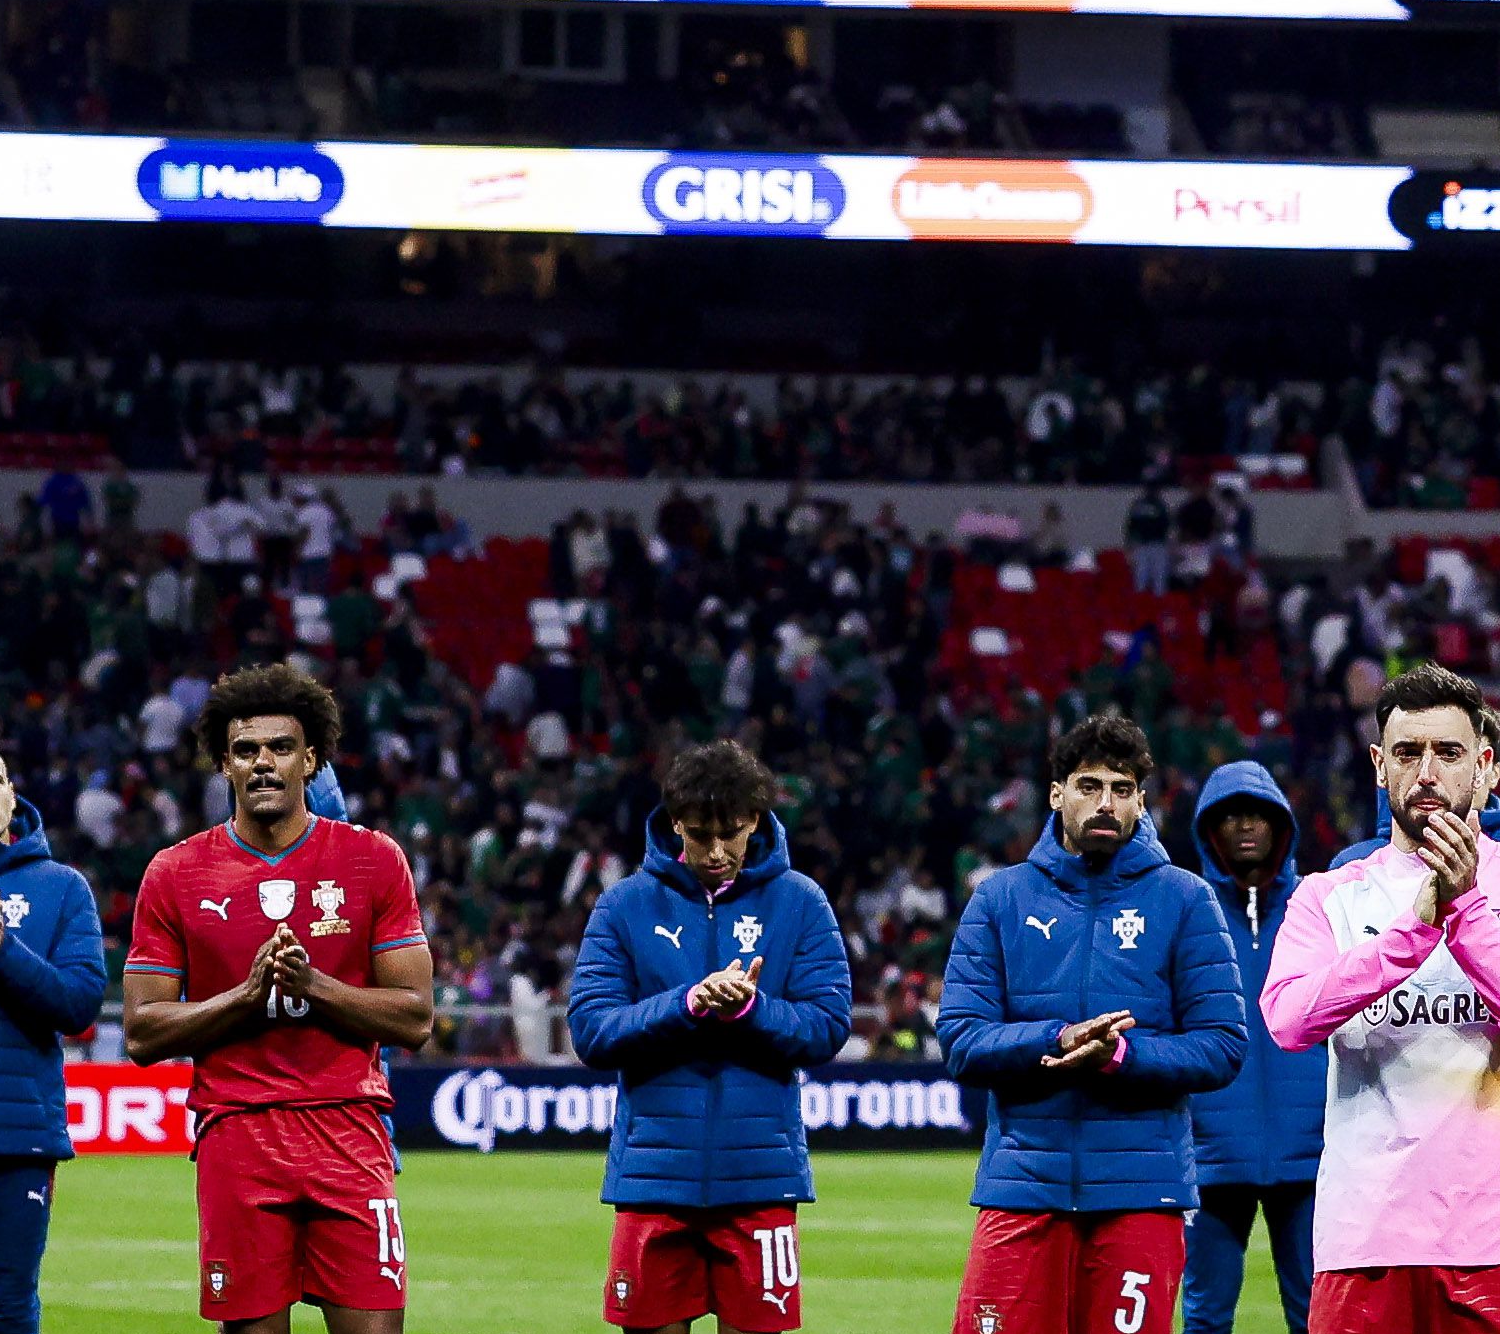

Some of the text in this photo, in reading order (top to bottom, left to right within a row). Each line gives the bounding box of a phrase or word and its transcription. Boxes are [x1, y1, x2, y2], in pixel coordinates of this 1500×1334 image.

[1390, 988, 1496, 1028] SAGRE
[431, 1067, 618, 1153] Coron
[753, 1224, 800, 1290] 10
[1113, 1270, 1151, 1334] 5
